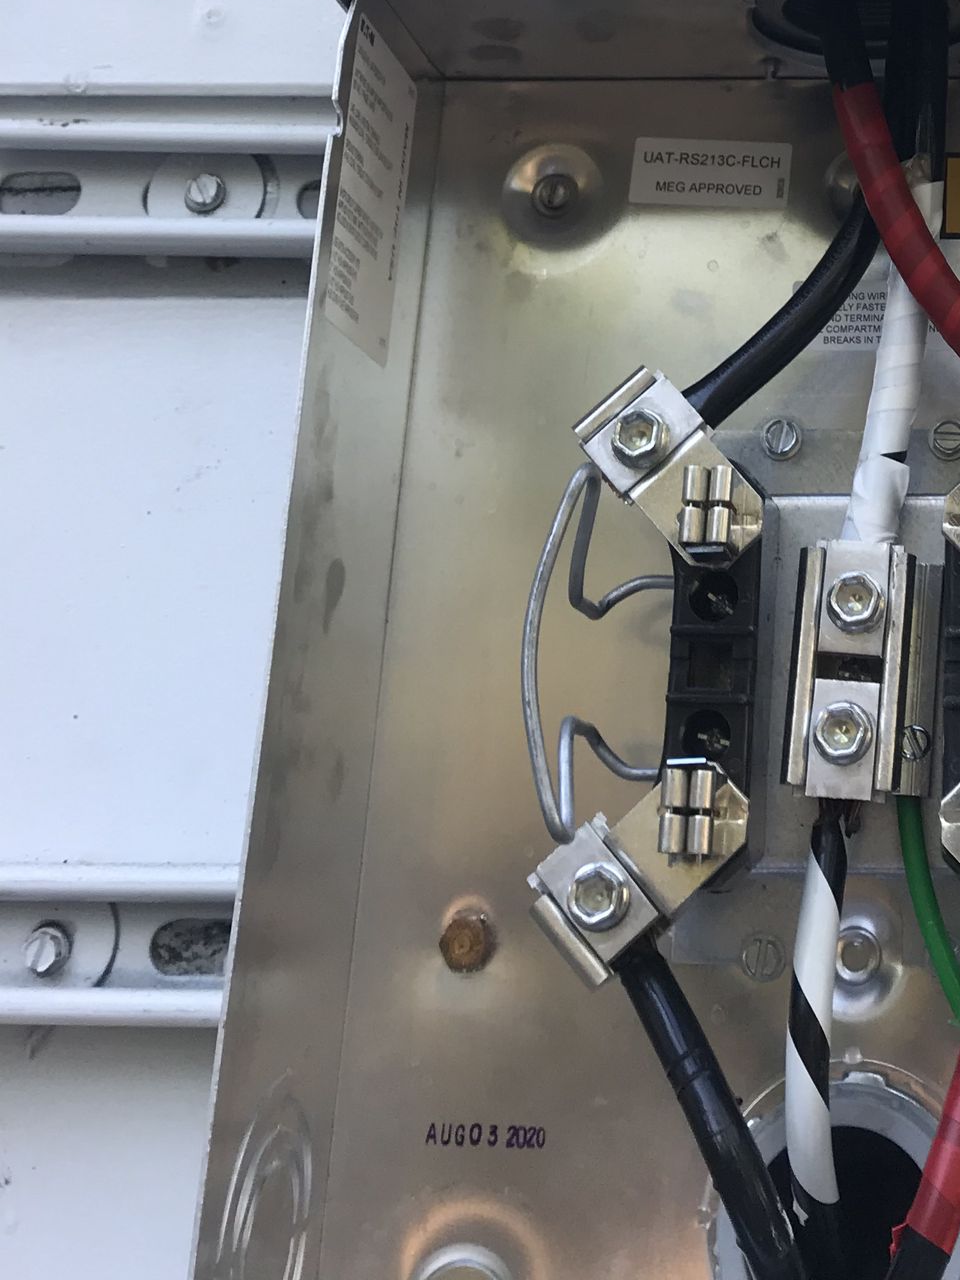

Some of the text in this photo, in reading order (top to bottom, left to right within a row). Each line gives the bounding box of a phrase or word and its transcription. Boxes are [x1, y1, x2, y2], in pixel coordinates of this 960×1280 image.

[643, 151, 781, 169] UAT-RS213C-FLCH
[655, 180, 686, 193] MEG
[689, 182, 762, 196] APPROVED
[866, 292, 886, 301] WIR
[855, 302, 886, 312] FASTE
[844, 313, 885, 323] TERMINA
[825, 324, 881, 334] COMPARTM
[823, 336, 861, 345] BREAKS
[863, 336, 874, 345] IN
[505, 1125, 546, 1149] 2020
